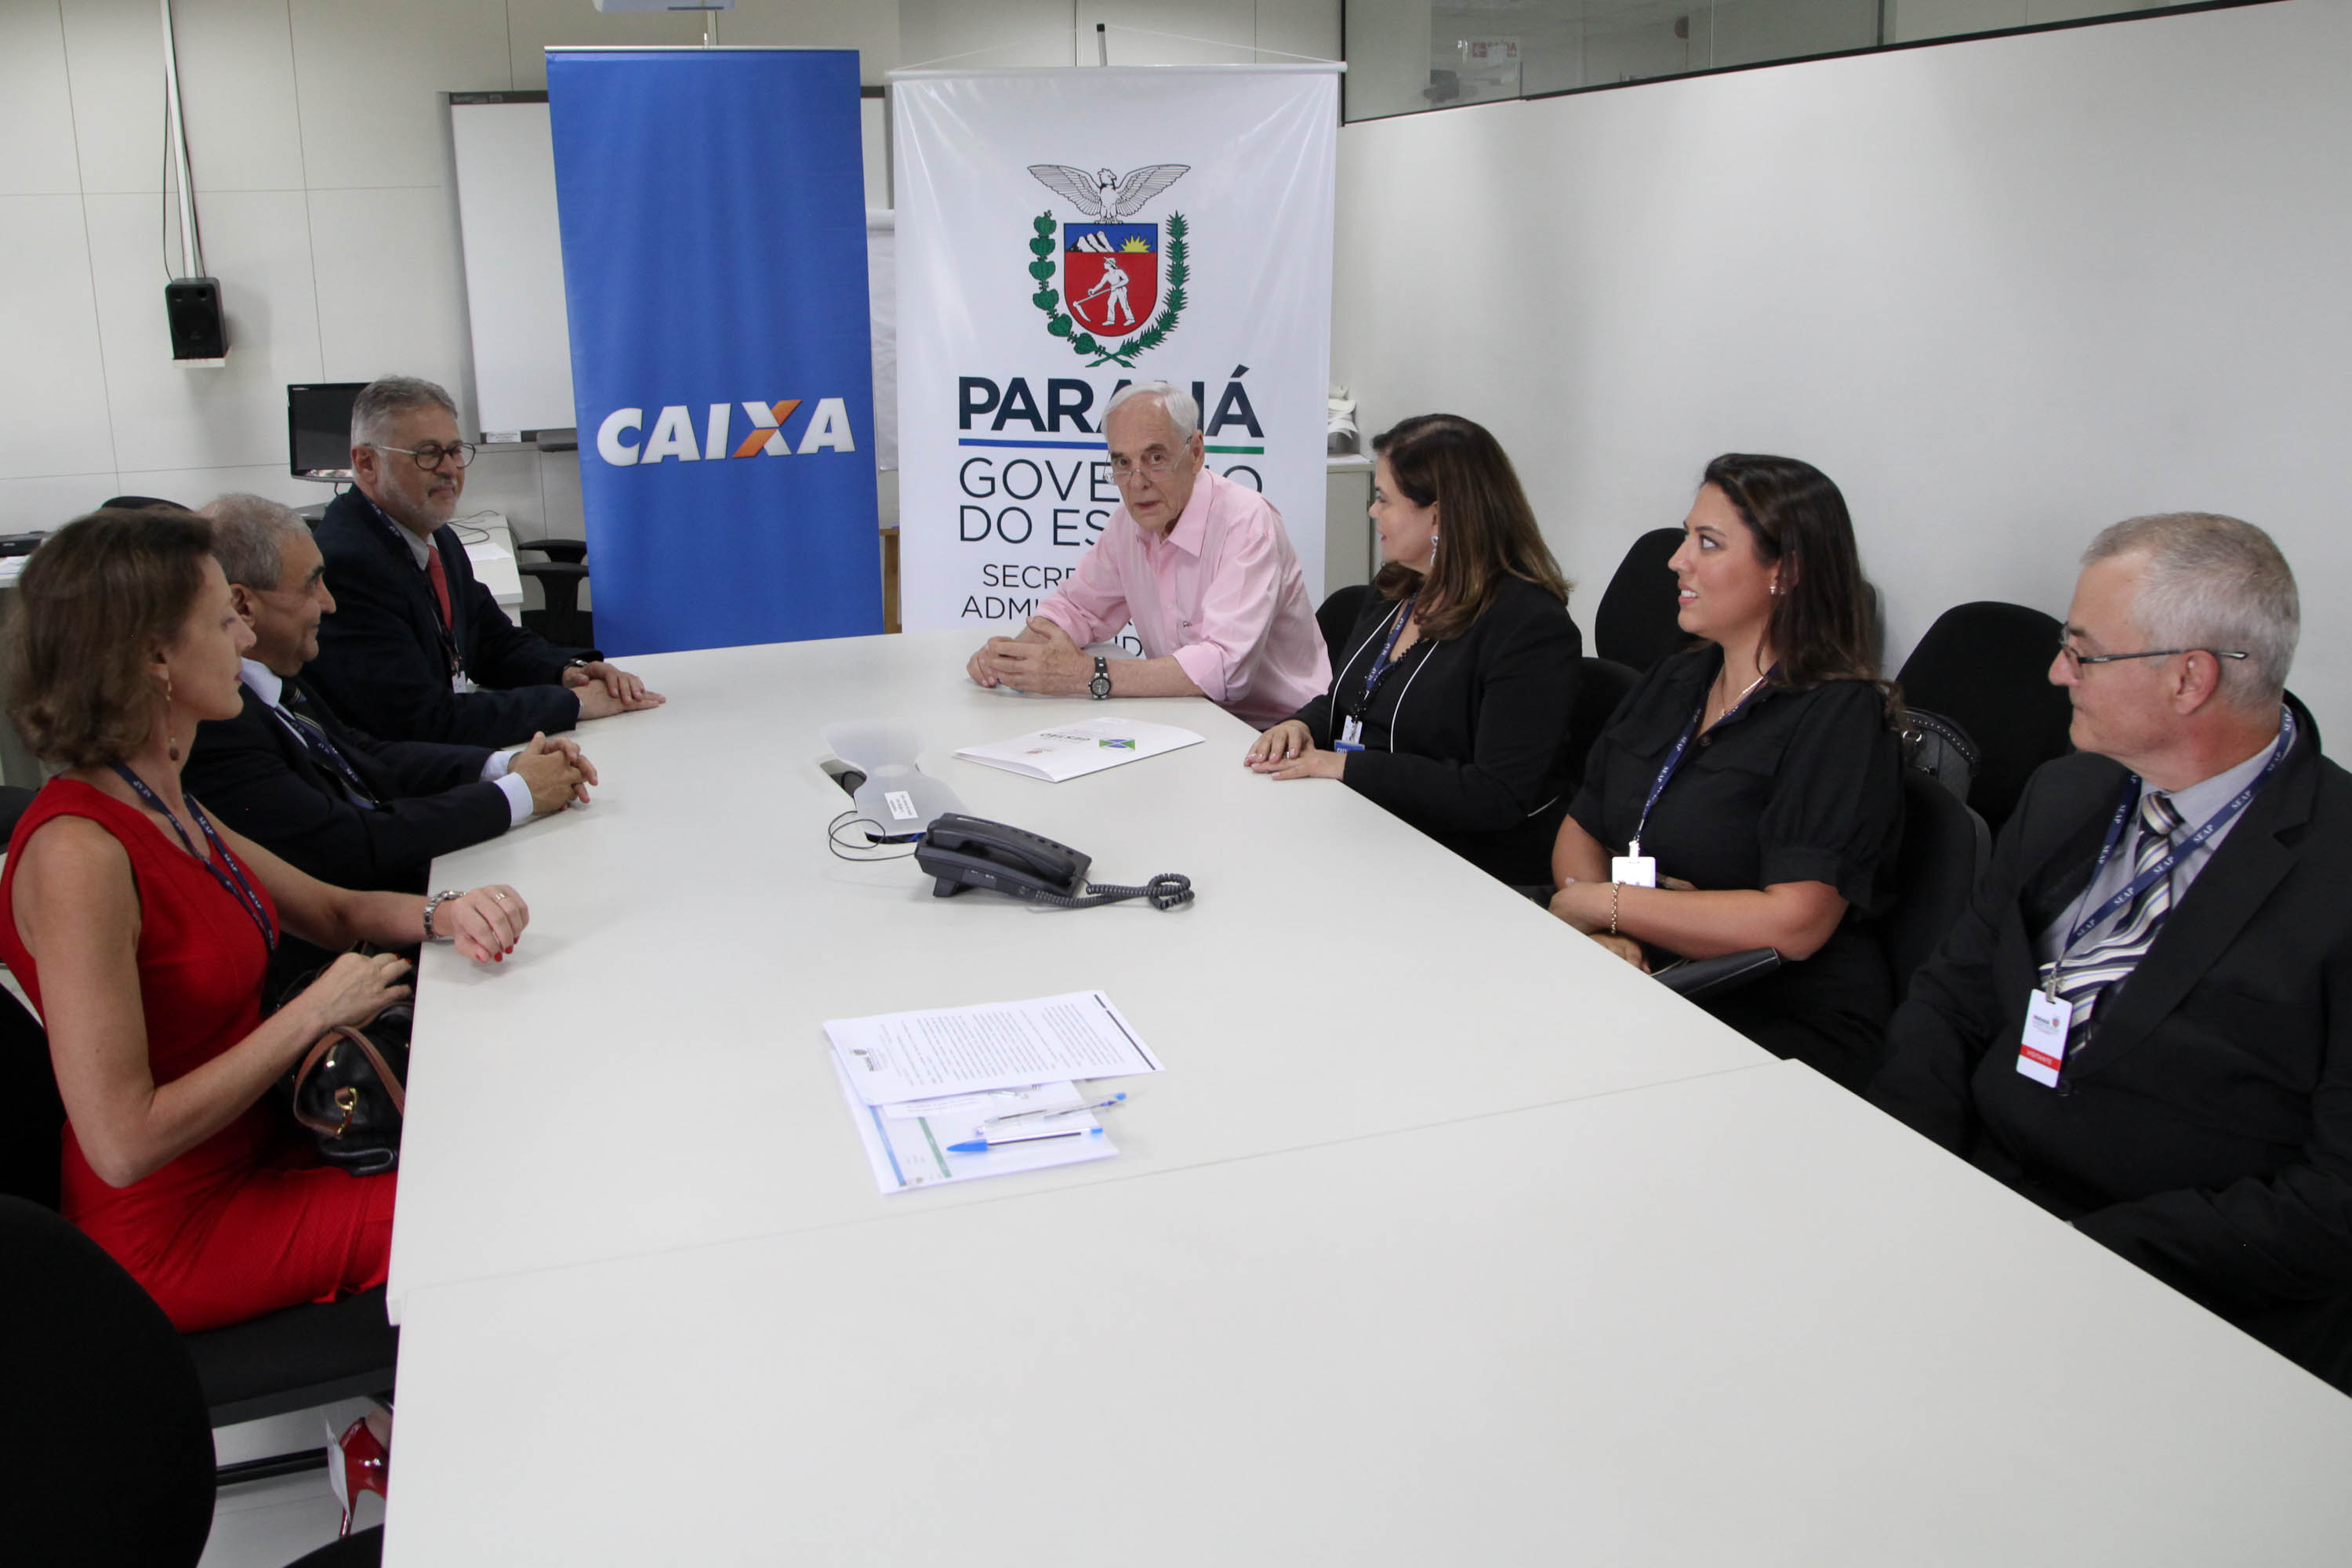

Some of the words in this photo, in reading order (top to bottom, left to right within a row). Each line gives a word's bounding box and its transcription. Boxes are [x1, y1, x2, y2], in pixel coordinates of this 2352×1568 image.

[958, 364, 1265, 438] PARÁ
[597, 397, 856, 467] CAIXA
[959, 456, 1263, 503] GOVEO
[960, 505, 1033, 544] DO
[2283, 712, 2293, 733] SEAP
[2230, 789, 2252, 808] SEAP
[198, 815, 215, 835] SEAP
[2193, 823, 2214, 842] SEAP
[2097, 844, 2111, 865] SEAP
[2153, 855, 2175, 873] SEAP
[2114, 887, 2135, 905] SEAP
